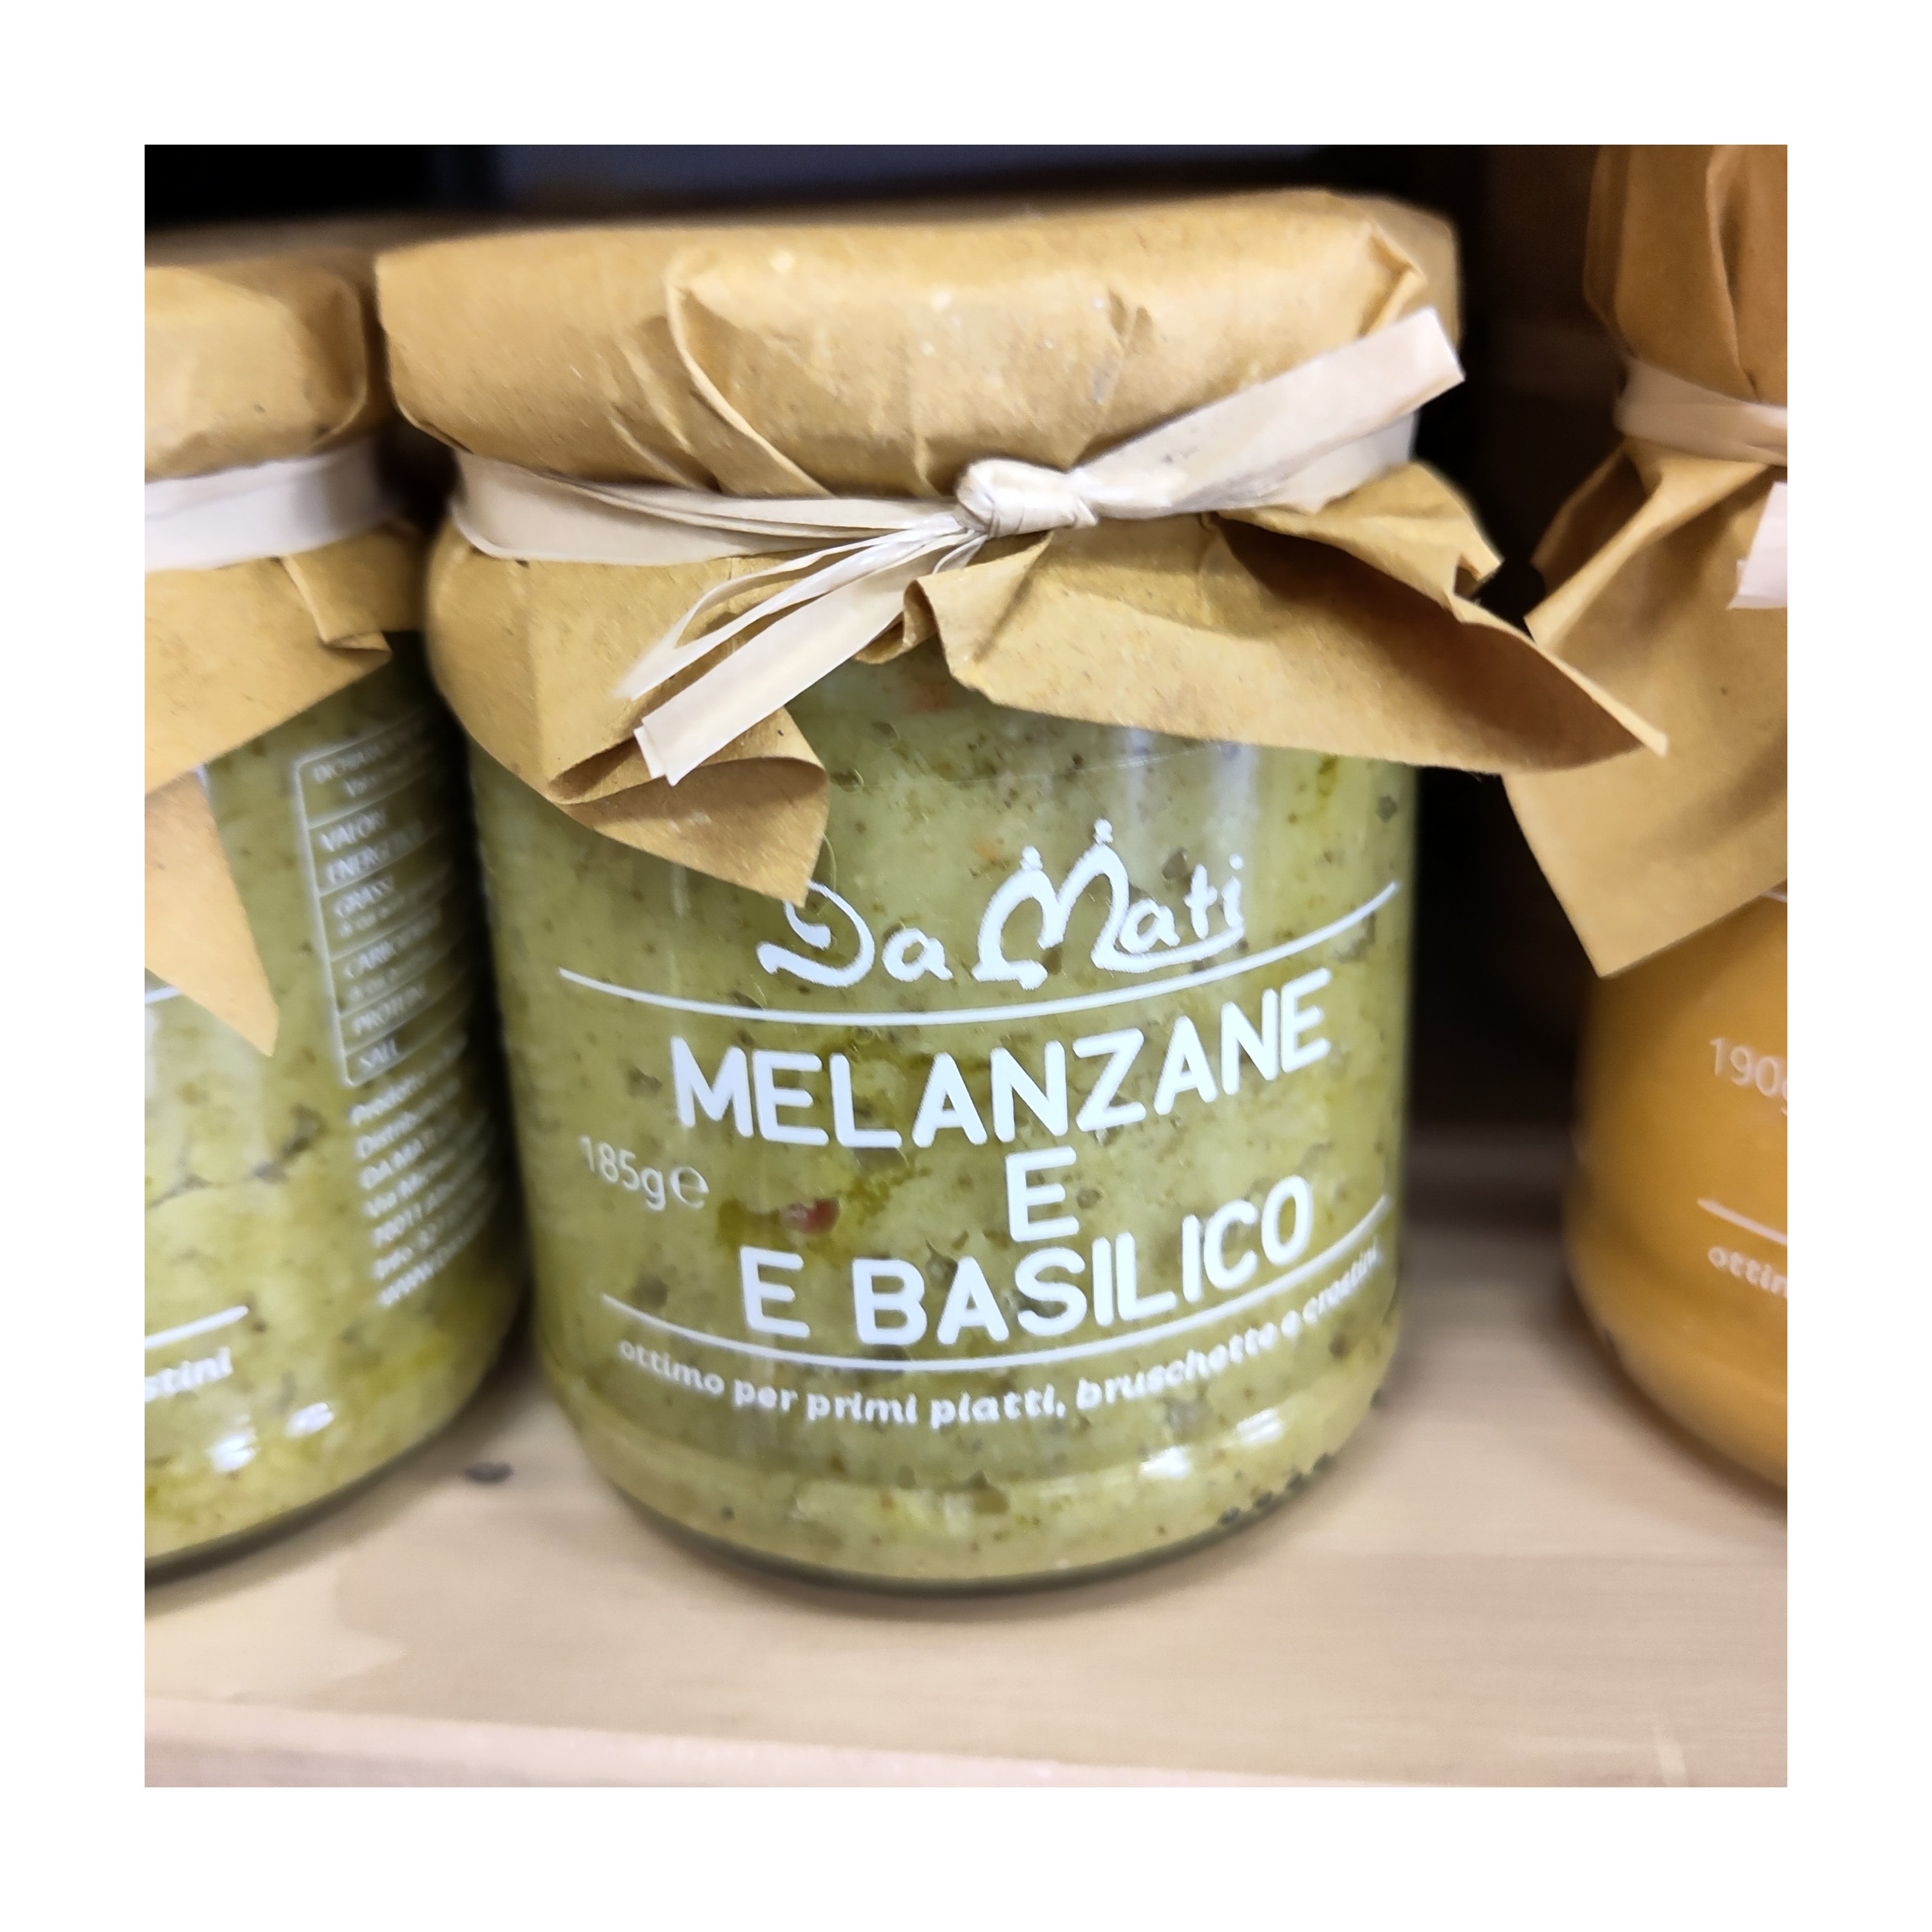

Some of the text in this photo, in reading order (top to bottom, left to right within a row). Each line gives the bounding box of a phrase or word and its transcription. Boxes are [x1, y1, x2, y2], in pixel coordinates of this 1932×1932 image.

[670, 967, 1333, 1149] MELANZANE
[739, 1174, 1315, 1347] E BASILICO
[1004, 1144, 1079, 1244] E
[618, 1339, 725, 1395] ottimo
[733, 1378, 799, 1413] per
[806, 1392, 917, 1424] primi
[930, 1382, 1066, 1430] piatti,
[1280, 1309, 1302, 1339] e
